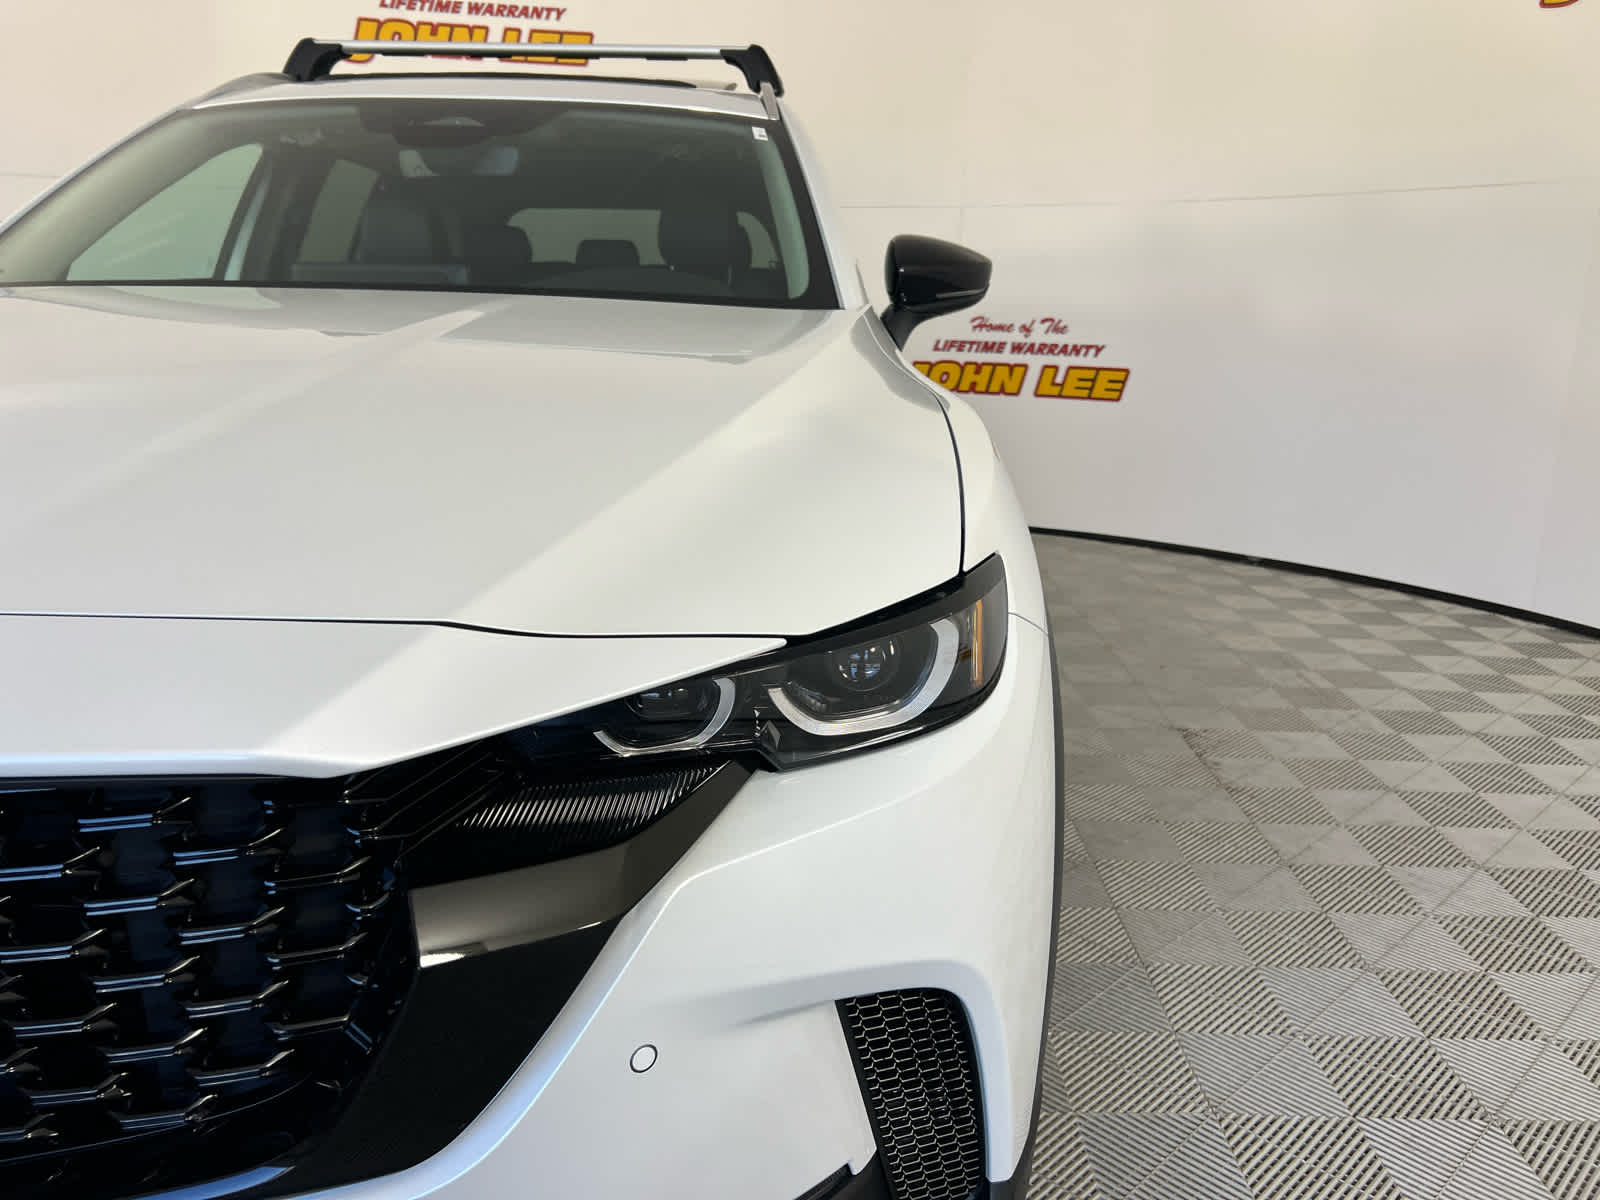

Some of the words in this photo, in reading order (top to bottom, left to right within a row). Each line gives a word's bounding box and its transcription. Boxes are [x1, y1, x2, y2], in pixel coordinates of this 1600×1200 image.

[379, 0, 463, 14] LIFETIME
[467, 1, 567, 21] WARRANTY
[970, 316, 1015, 333] Home
[1019, 319, 1035, 338] of
[1040, 318, 1069, 335] The
[933, 339, 1007, 354] LIFETIME
[1010, 342, 1106, 358] WARRANTY
[1034, 365, 1130, 402] LEE
